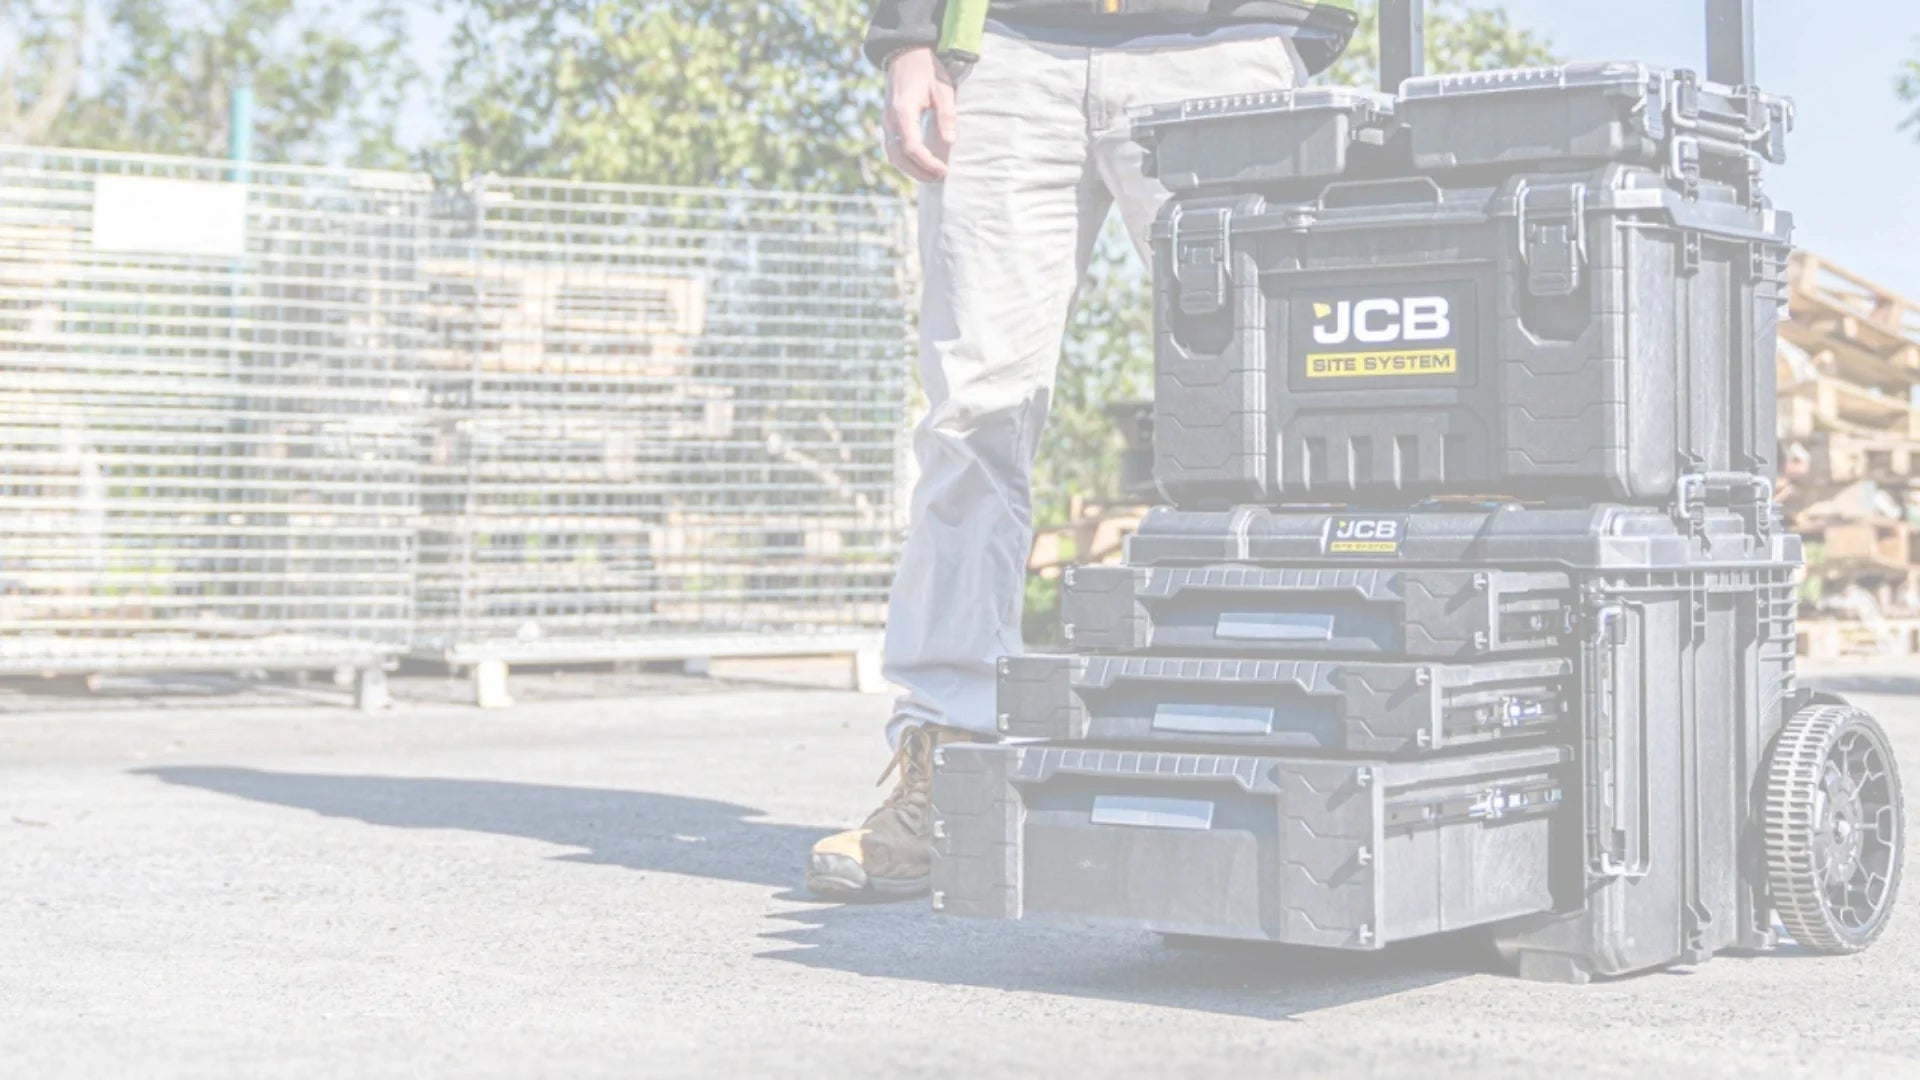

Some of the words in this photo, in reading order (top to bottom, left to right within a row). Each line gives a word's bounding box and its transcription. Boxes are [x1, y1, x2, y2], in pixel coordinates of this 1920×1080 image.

[1313, 296, 1450, 343] JCB
[1313, 358, 1356, 372] SITE
[1364, 355, 1450, 371] SYSTEM
[1336, 520, 1398, 538] JCB
